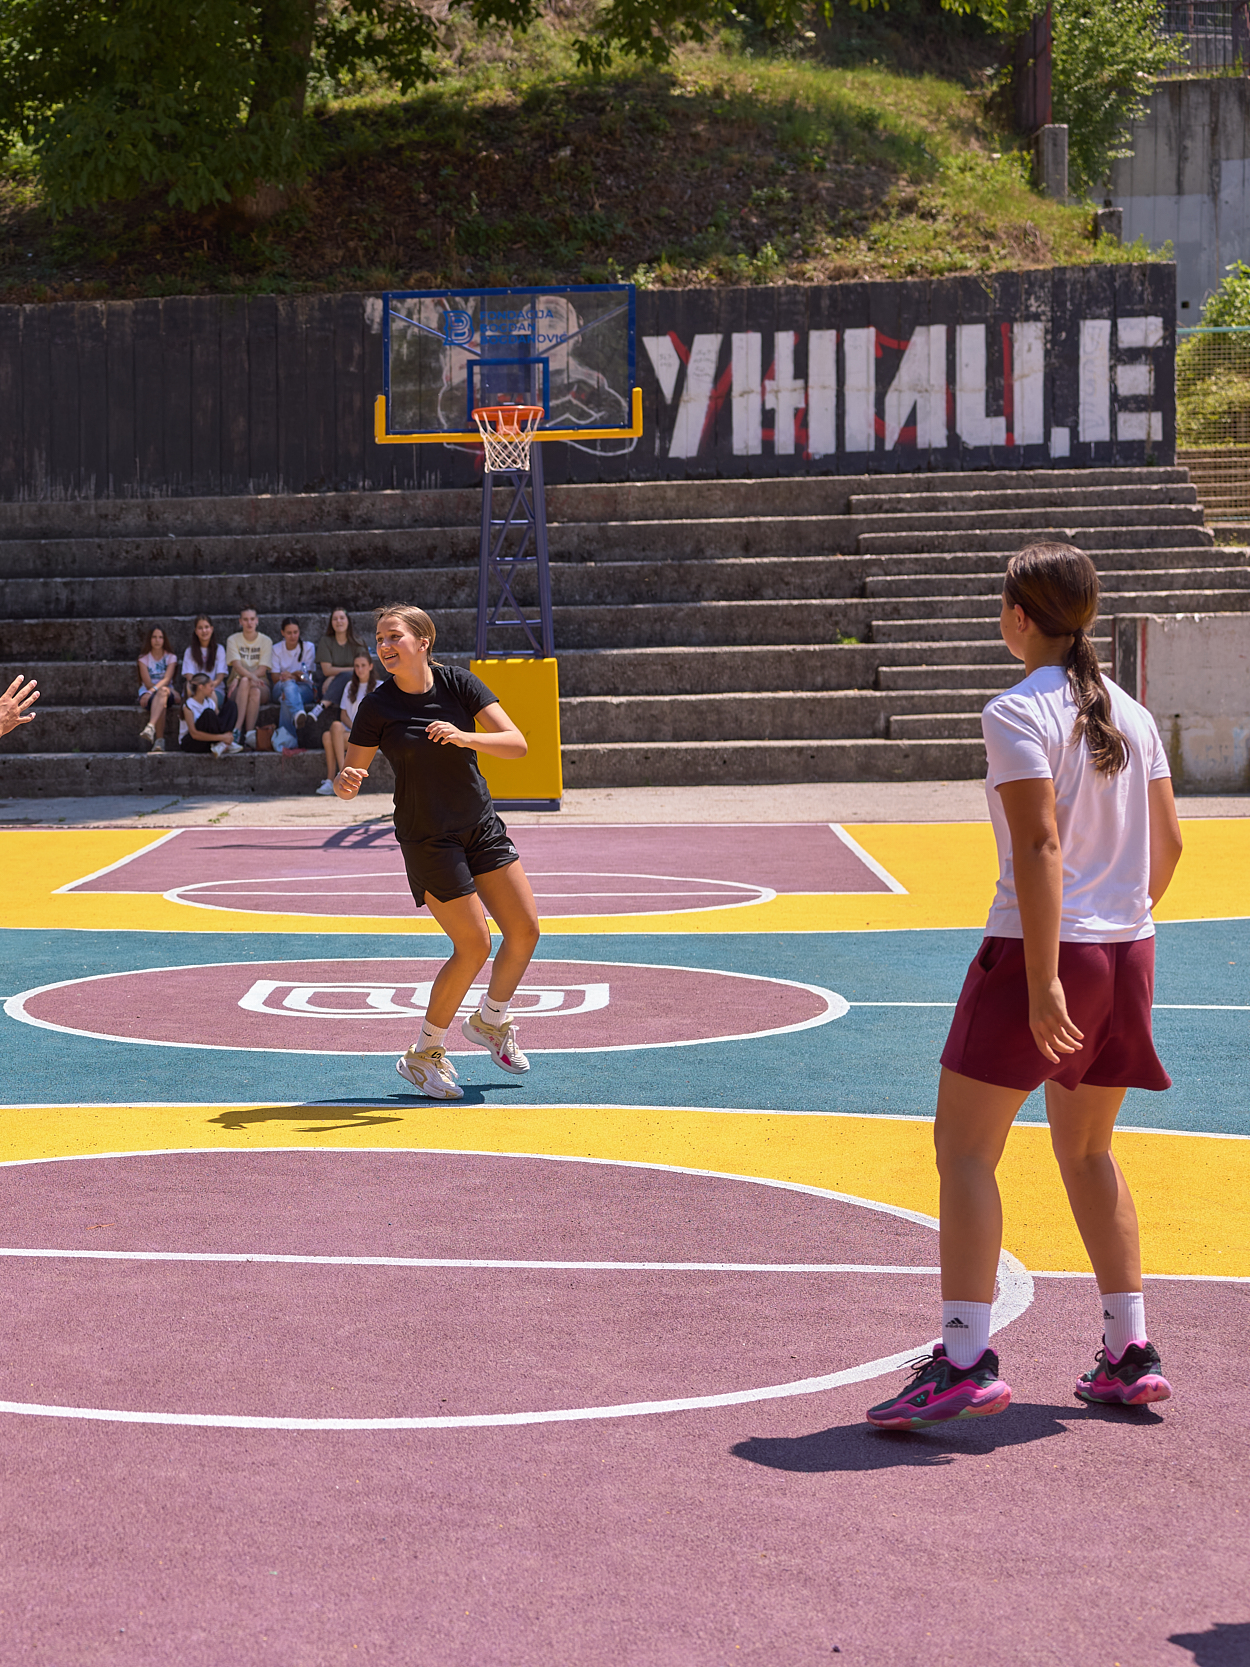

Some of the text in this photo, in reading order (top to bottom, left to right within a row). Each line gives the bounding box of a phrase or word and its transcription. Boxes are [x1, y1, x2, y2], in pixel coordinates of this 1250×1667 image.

[480, 310, 554, 320] FONDACIJA
[480, 323, 536, 333] BOGDAN
[480, 331, 568, 345] BOGDANOVIĆ
